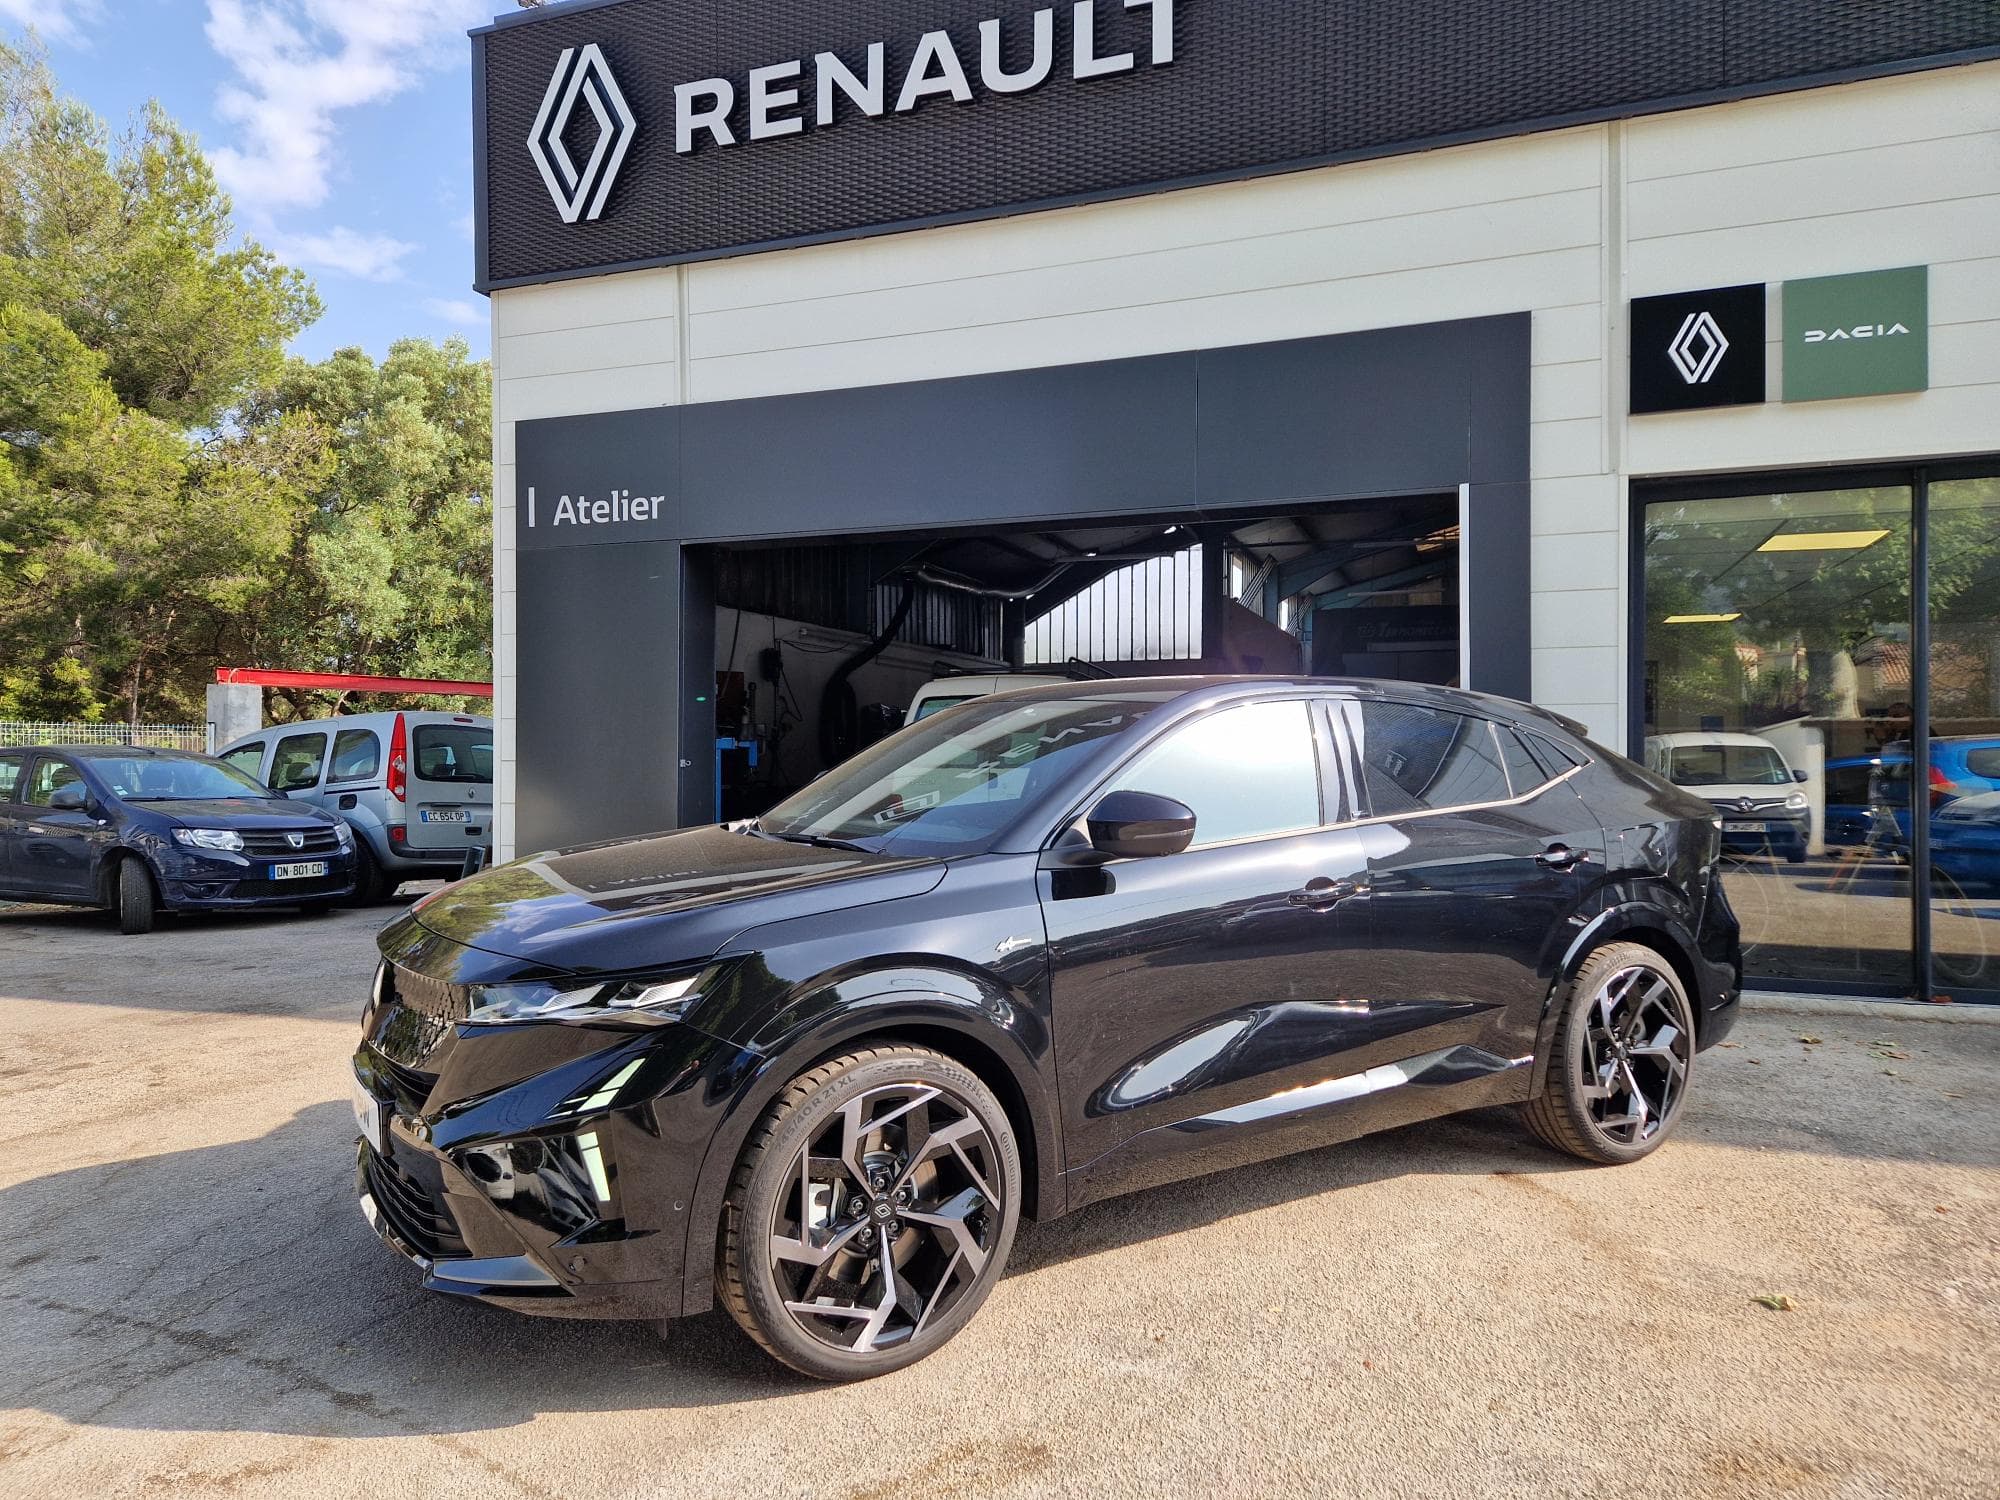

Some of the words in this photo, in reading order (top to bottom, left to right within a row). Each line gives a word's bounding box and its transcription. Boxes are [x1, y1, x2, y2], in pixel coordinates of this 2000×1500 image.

[674, 0, 1174, 154] RENAULT
[1804, 322, 1910, 343] DACIA
[553, 489, 665, 526] Atelier
[427, 812, 439, 821] CC
[775, 1106, 812, 1152] 245/40
[811, 1097, 822, 1109] R
[822, 1085, 837, 1100] 21
[837, 1075, 857, 1089] XL
